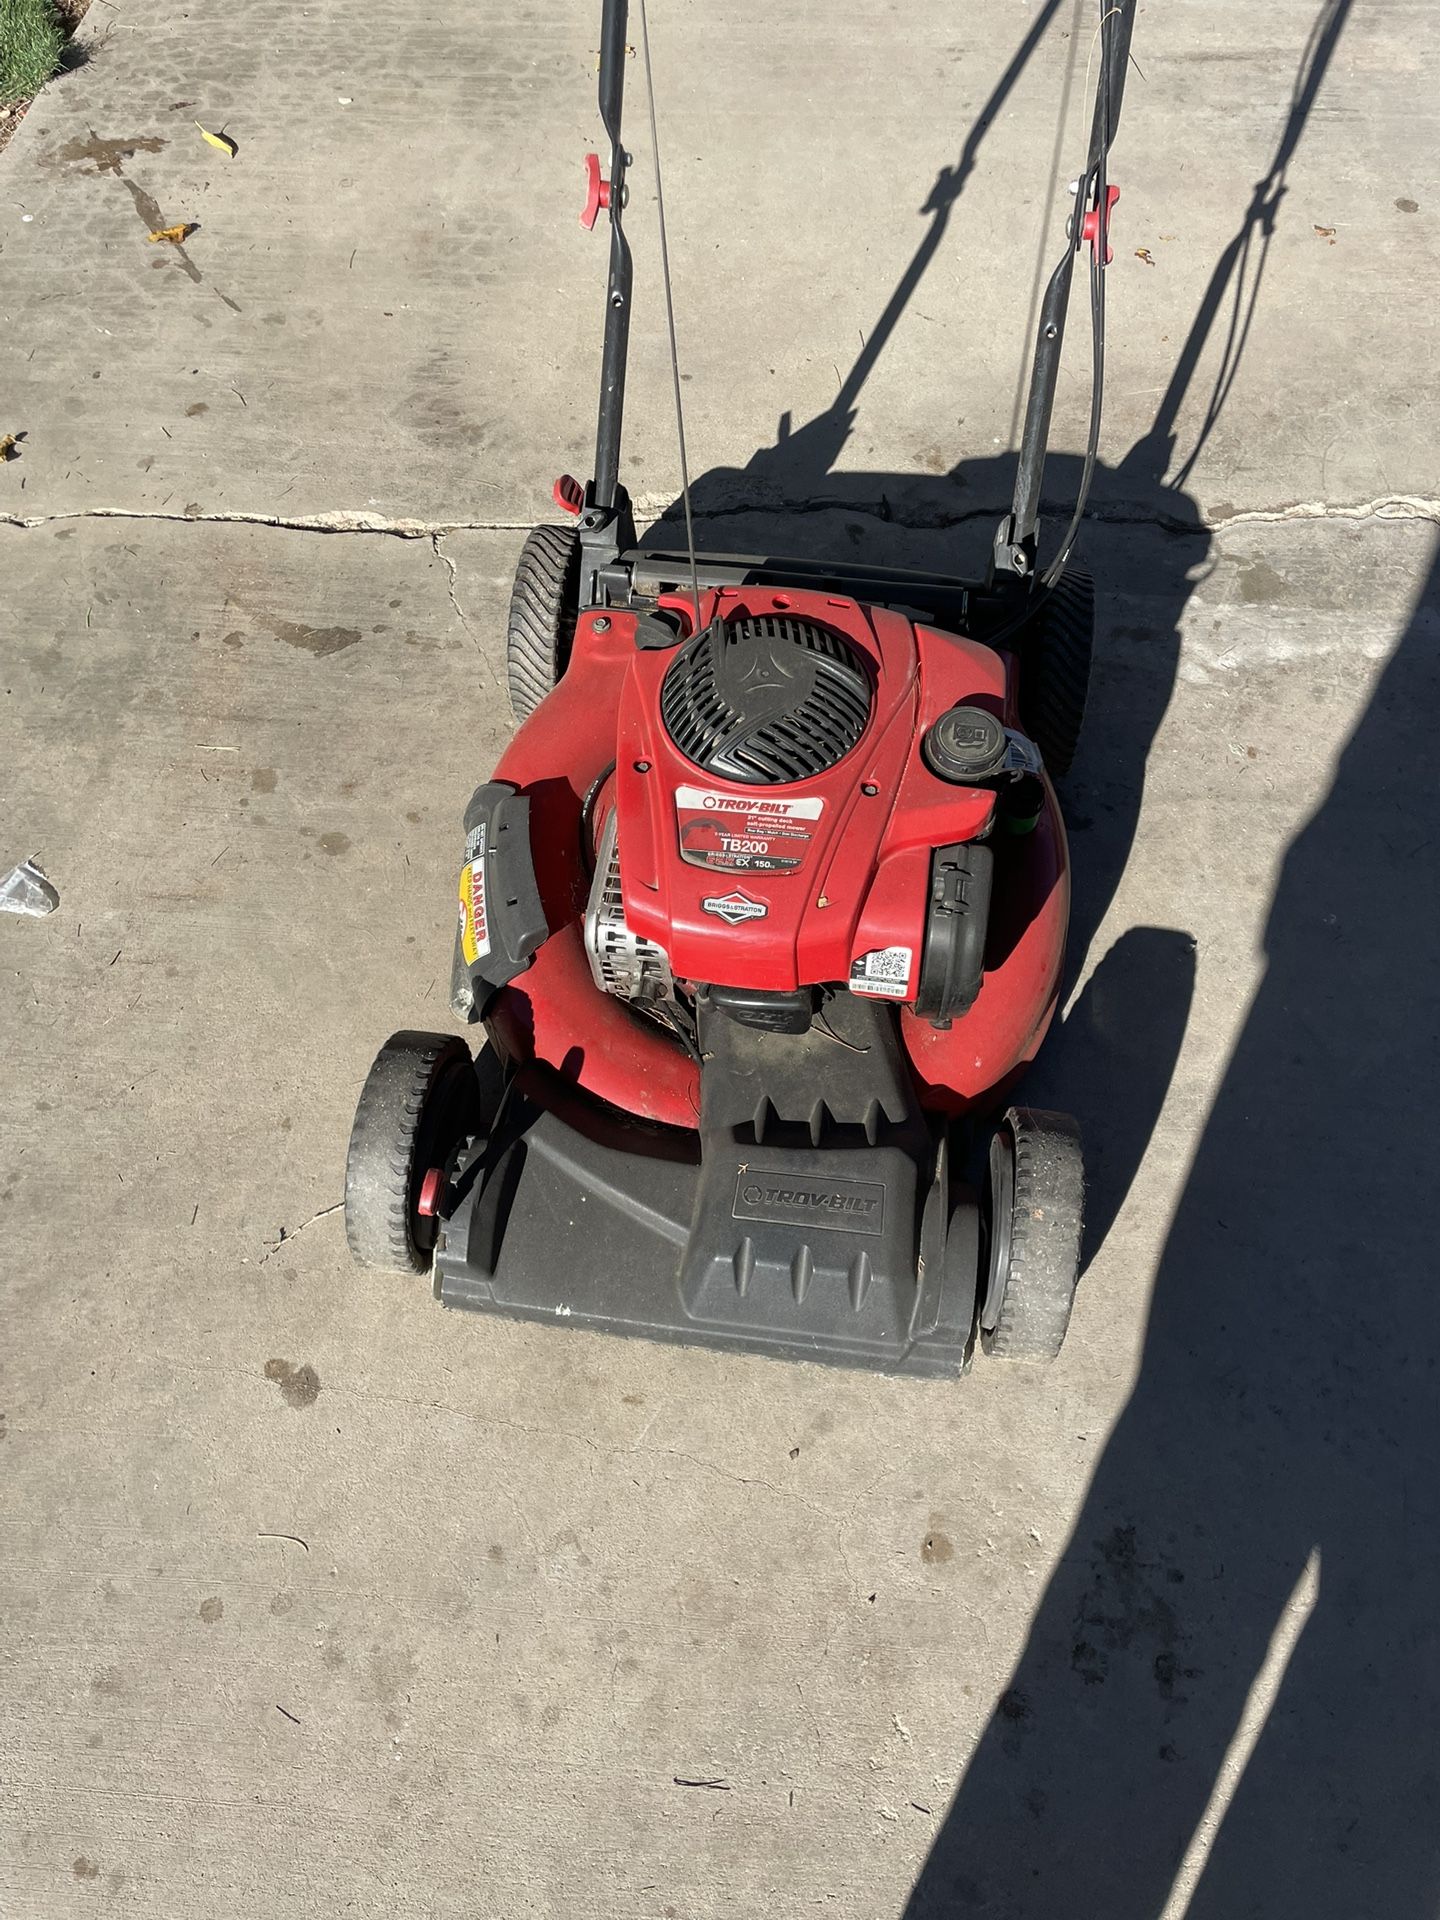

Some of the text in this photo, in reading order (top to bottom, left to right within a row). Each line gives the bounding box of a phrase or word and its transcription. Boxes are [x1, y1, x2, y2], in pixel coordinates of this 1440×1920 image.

[718, 799, 790, 814] TROY-BILT
[721, 838, 768, 854] TB200
[473, 871, 487, 942] DANGER
[765, 1188, 879, 1213] TROY-BILT
